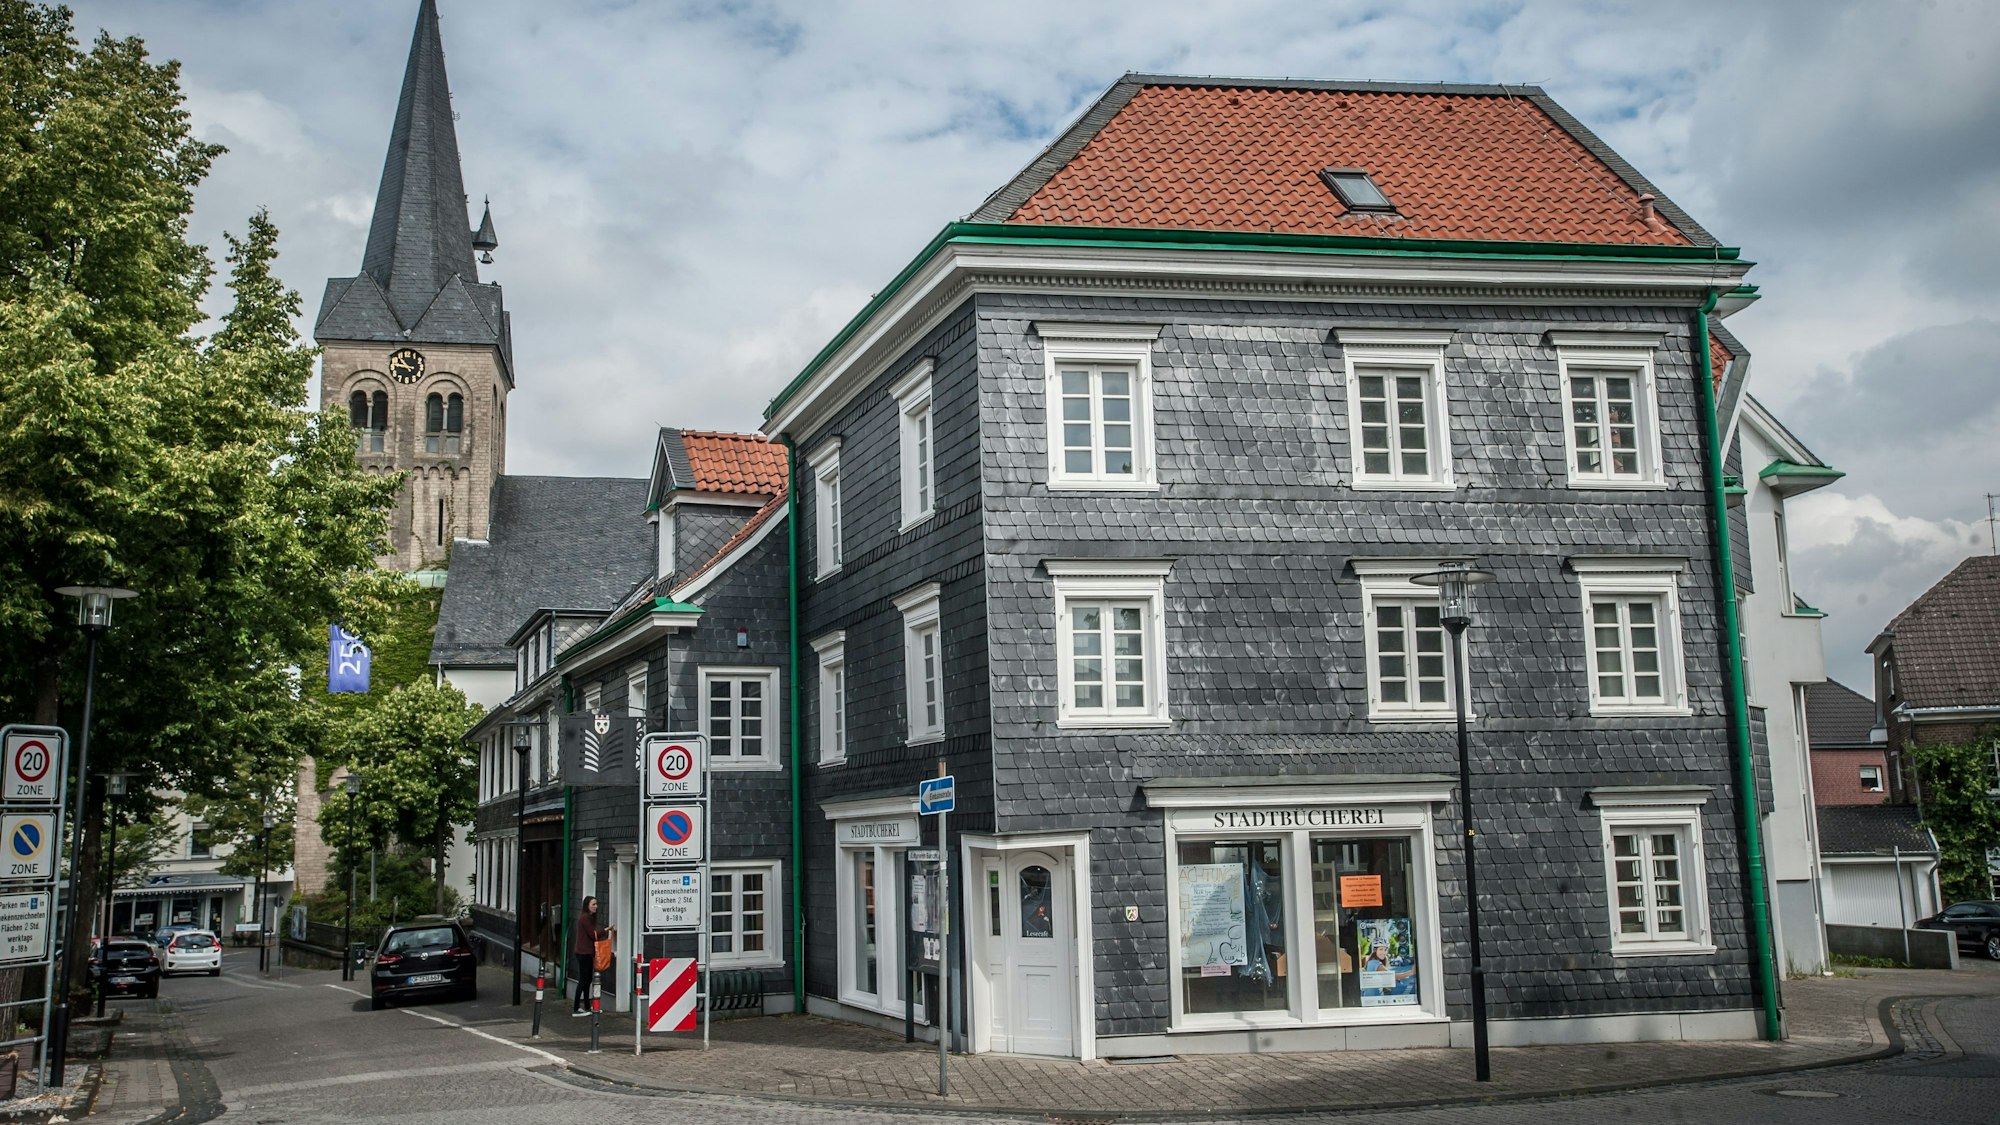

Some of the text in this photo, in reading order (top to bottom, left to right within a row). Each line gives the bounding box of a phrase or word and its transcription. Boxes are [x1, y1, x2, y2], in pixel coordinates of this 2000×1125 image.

[22, 752, 43, 771] 20
[665, 754, 685, 771] 20
[17, 784, 45, 796] ZONE
[661, 782, 689, 792] ZONE
[1214, 808, 1384, 828] STADTBÜCHEREI
[850, 822, 900, 839] STADTBÜCHEREI
[661, 847, 689, 857] ZONE
[11, 863, 39, 875] ZONE
[672, 877, 681, 885] mit
[691, 876, 697, 884] in
[650, 887, 699, 896] gekennzeichneten
[19, 900, 29, 909] mit
[39, 898, 45, 907] in
[655, 895, 693, 904] Flächen 2 Std.
[662, 906, 687, 914] werktags
[0, 911, 46, 922] ekennzeichneten
[1, 921, 40, 932] Flächen 2 Std.
[7, 934, 33, 944] werktags
